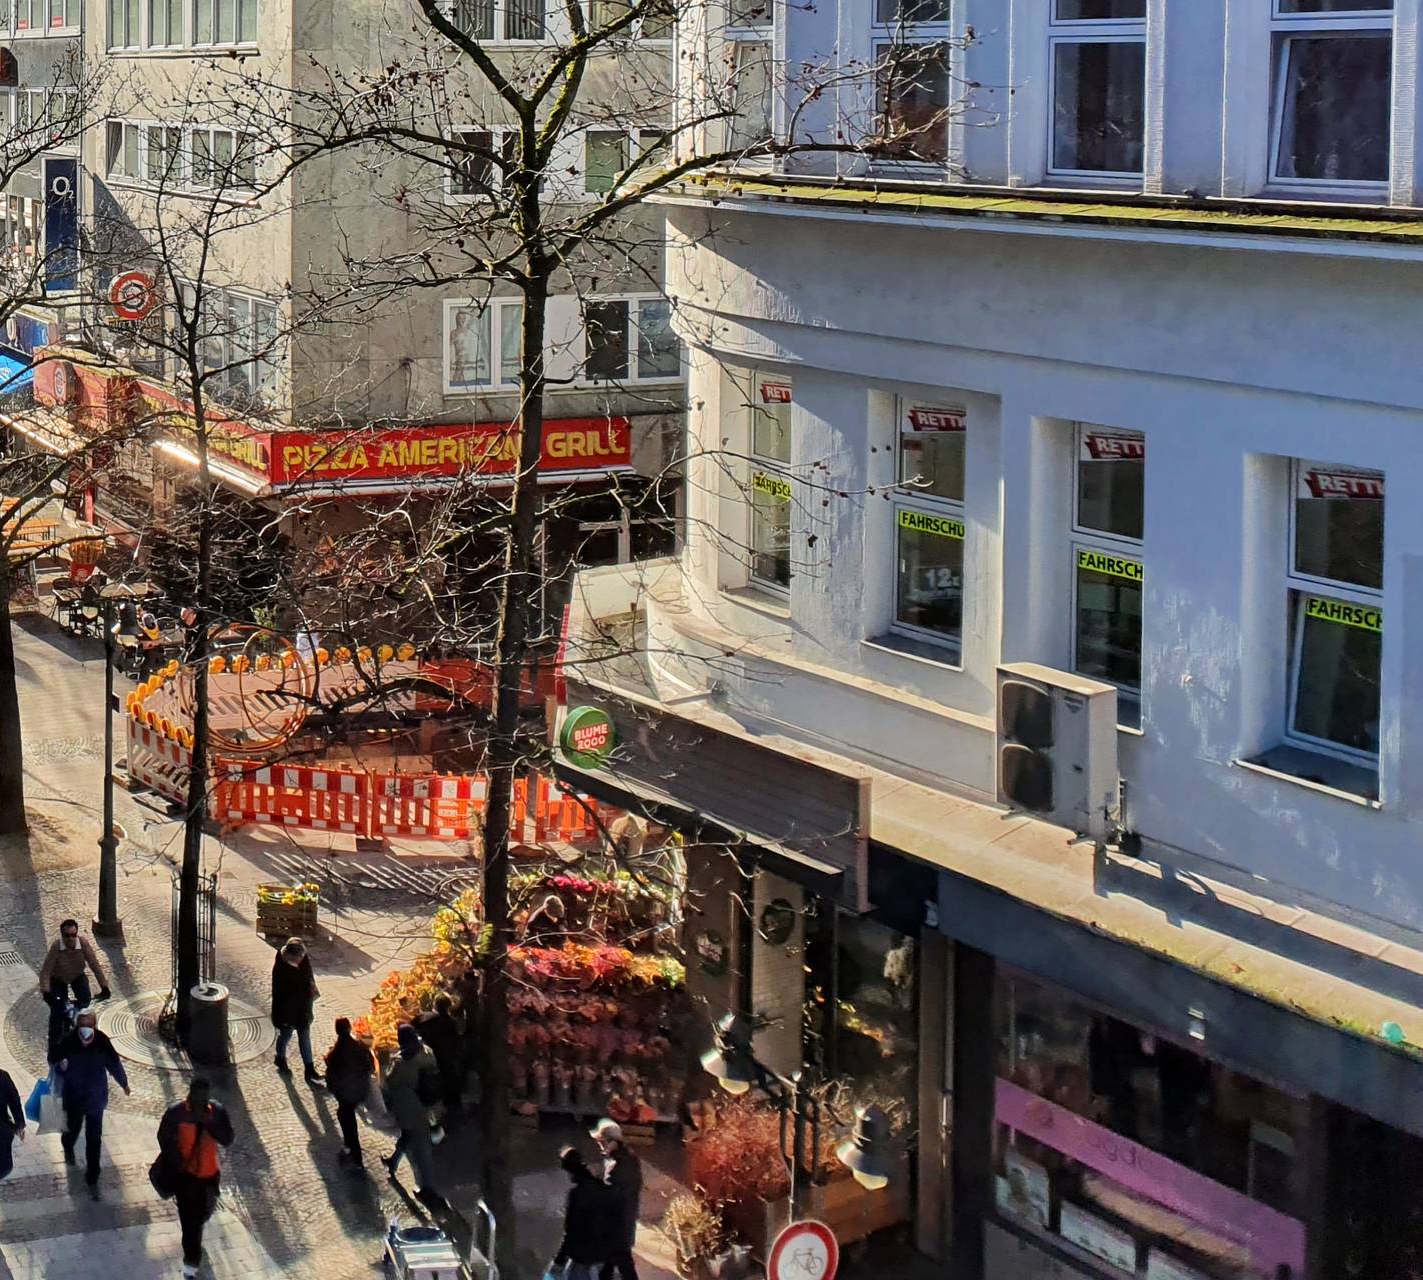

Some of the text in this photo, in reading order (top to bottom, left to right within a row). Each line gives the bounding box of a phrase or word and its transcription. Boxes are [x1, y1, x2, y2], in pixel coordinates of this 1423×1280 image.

[283, 443, 369, 472] PIZZA
[545, 430, 626, 458] GRILL
[1079, 551, 1143, 580] FAHRSCH
[575, 723, 608, 741] BLUME
[577, 736, 606, 751] 2000
